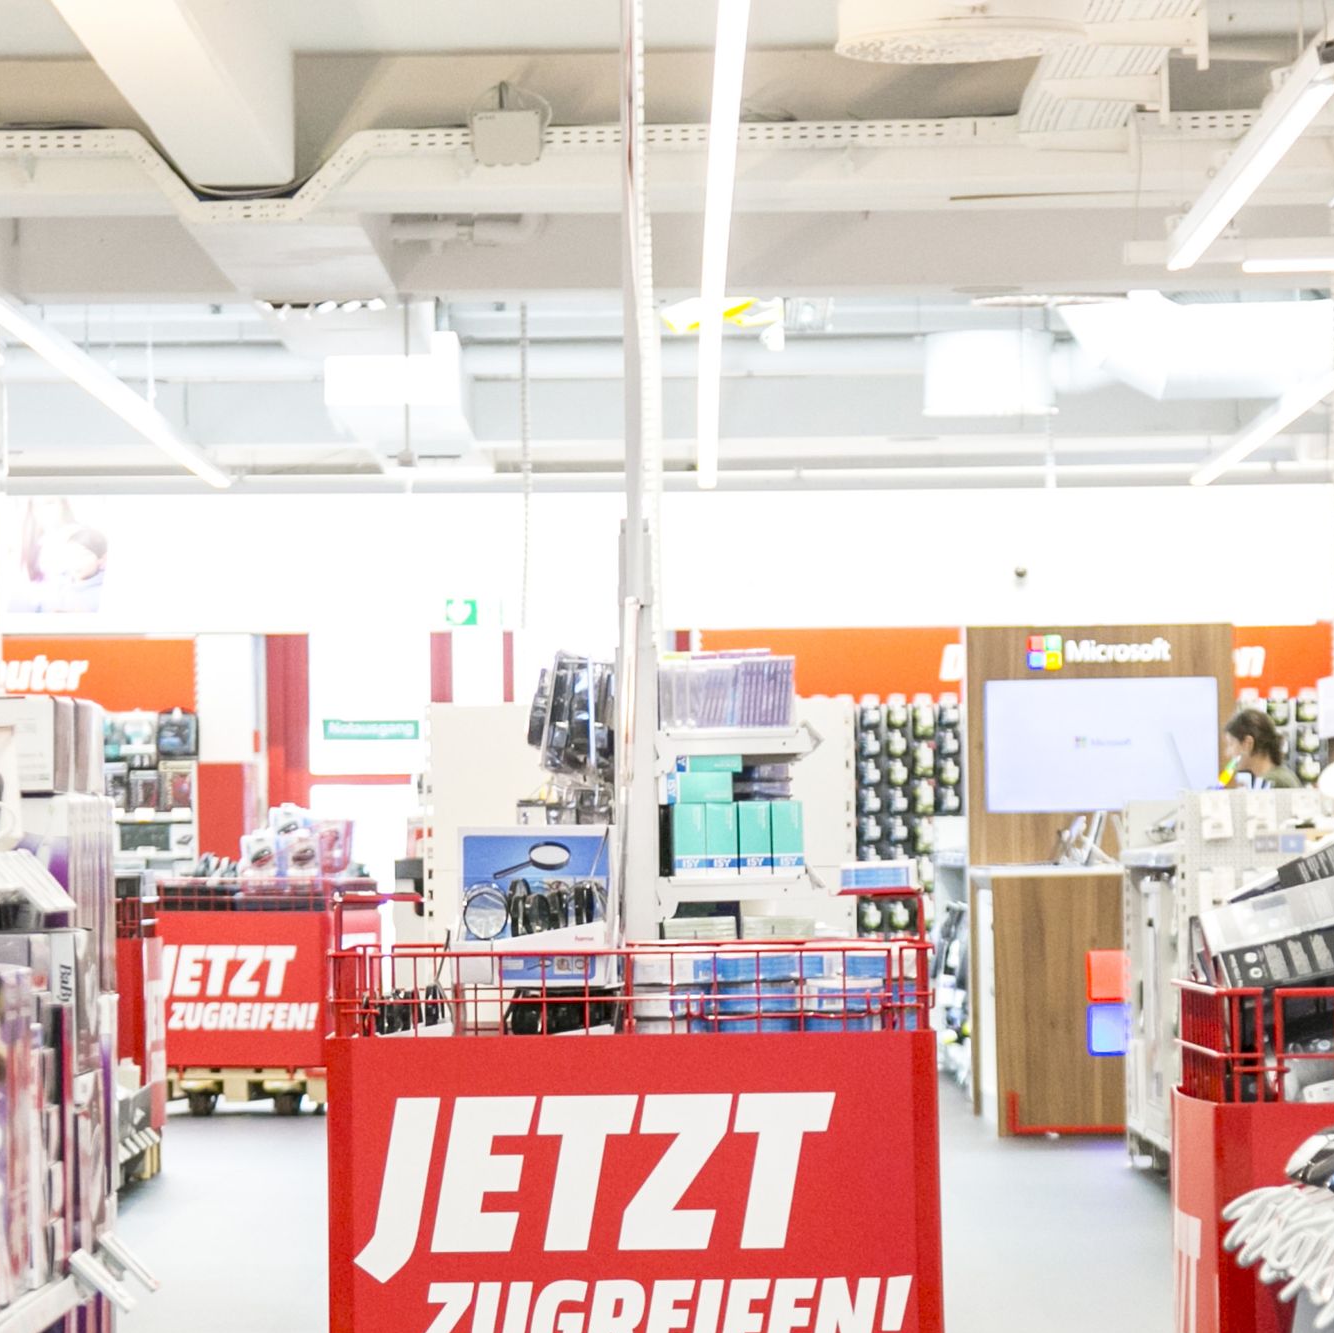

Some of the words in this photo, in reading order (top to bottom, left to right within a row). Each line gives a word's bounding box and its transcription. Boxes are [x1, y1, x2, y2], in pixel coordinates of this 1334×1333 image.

[1065, 637, 1171, 663] Microsoft
[168, 1002, 319, 1030] ZUGREIFEN!
[354, 1091, 836, 1284] JETZT
